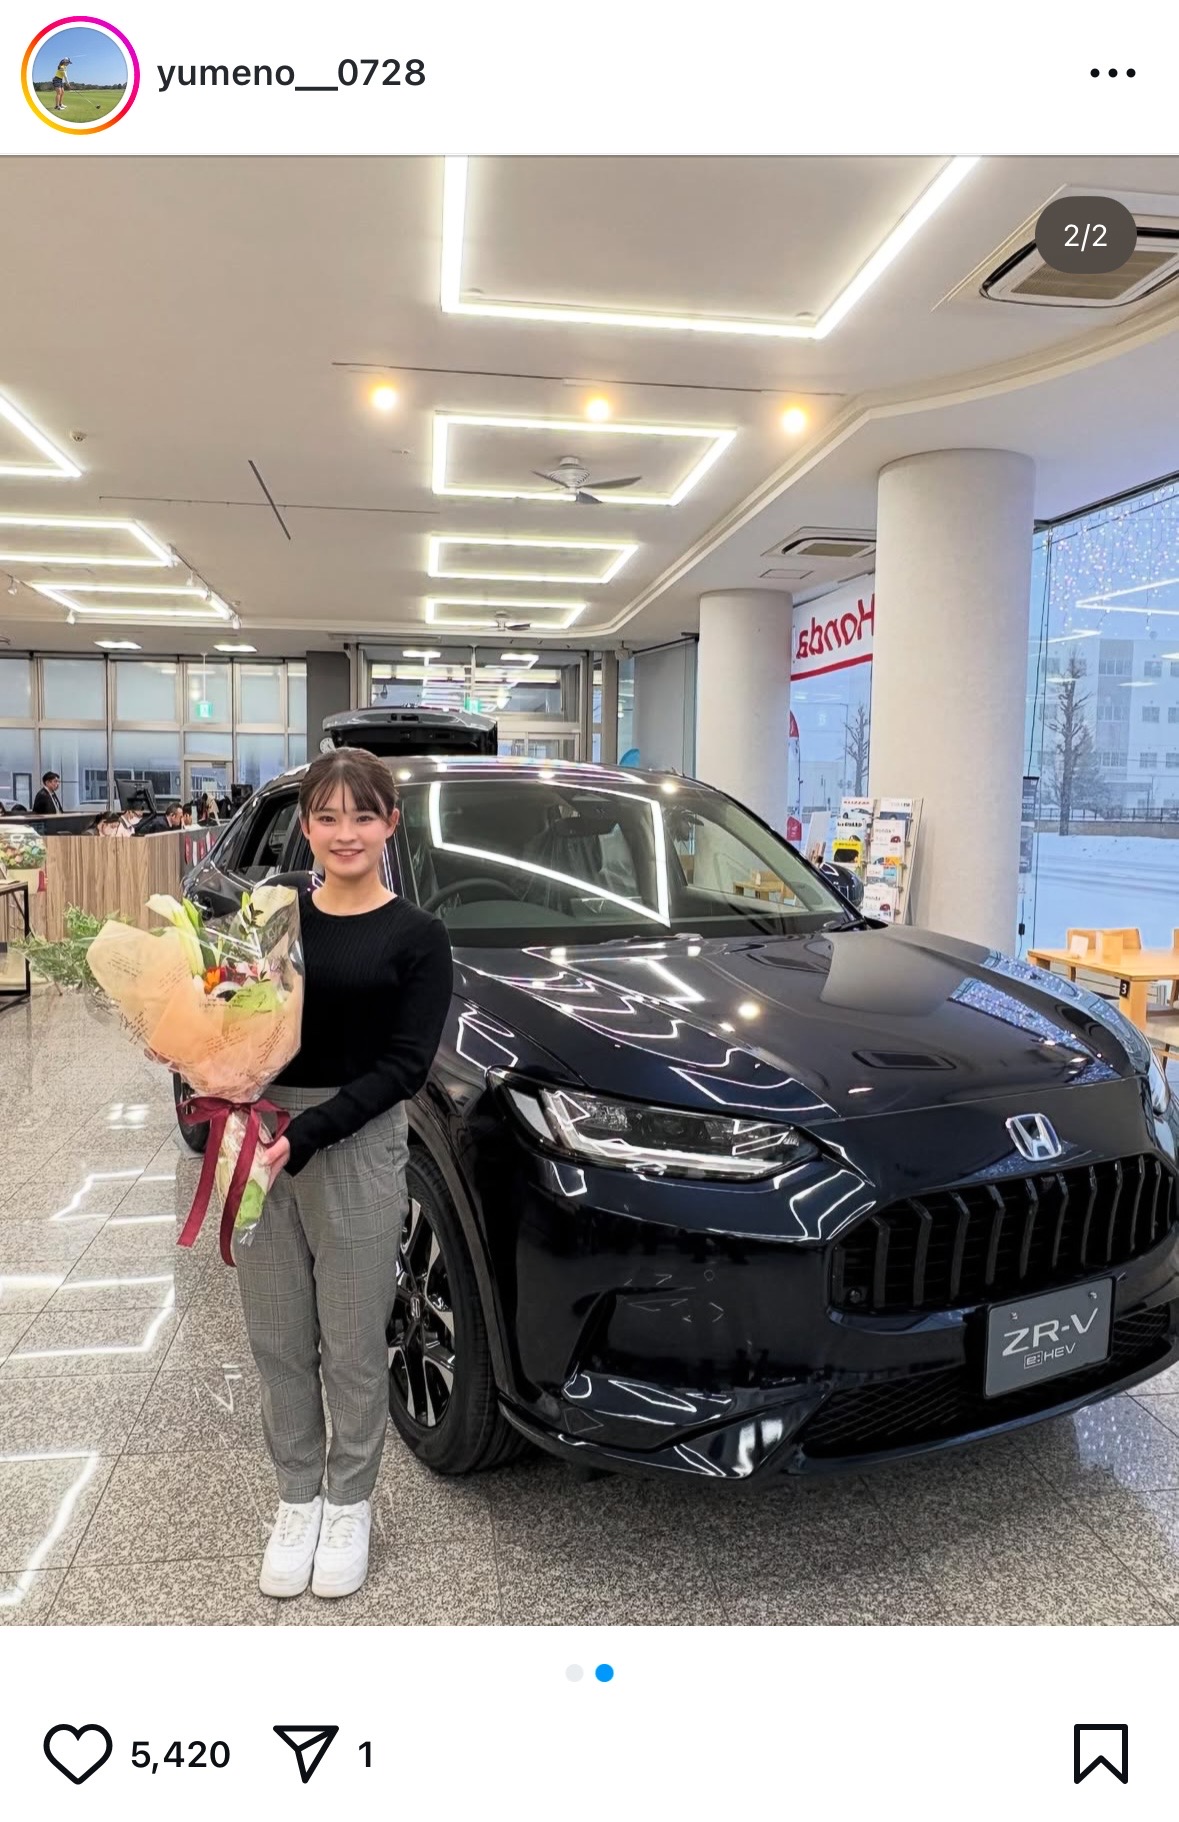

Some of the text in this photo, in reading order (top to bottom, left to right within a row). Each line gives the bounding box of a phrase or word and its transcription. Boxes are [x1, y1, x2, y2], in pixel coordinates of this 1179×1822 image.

[1121, 983, 1127, 995] 3
[1002, 1307, 1098, 1357] ZR-V
[1024, 1342, 1076, 1369] e:HEV
